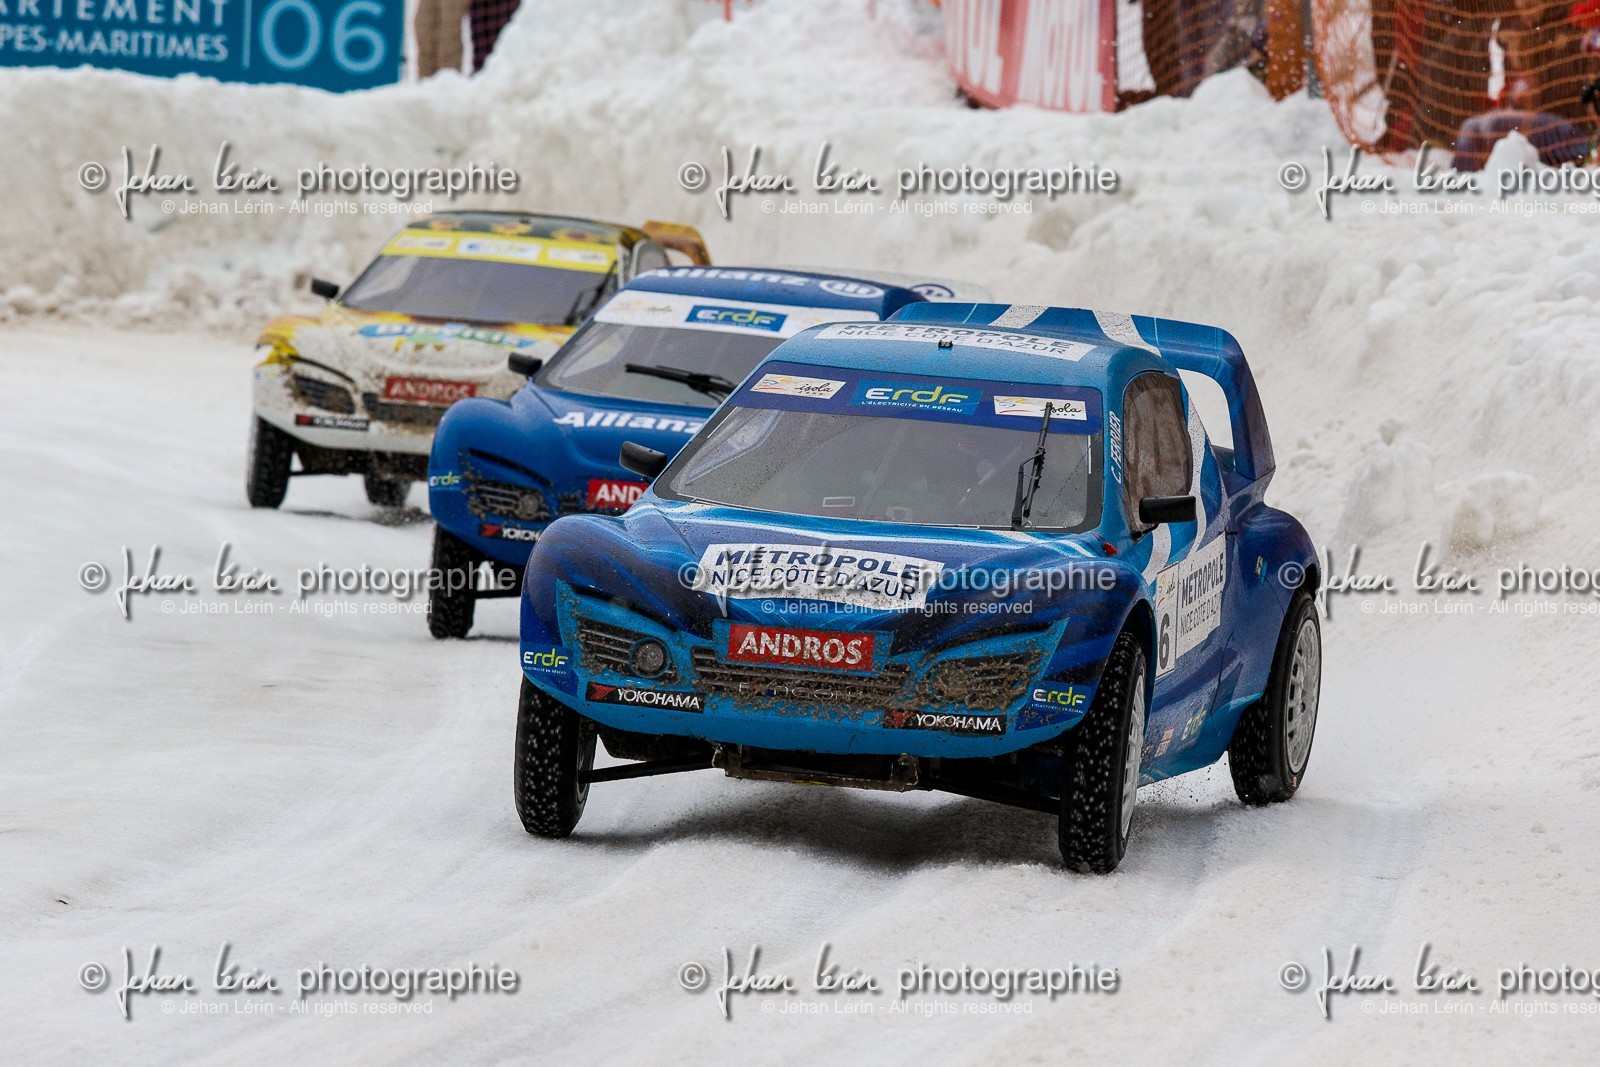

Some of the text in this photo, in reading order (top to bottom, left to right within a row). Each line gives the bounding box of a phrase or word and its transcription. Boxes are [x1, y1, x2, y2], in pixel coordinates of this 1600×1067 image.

[260, 0, 387, 75] 06
[553, 411, 703, 435] Allianz
[1109, 410, 1122, 470] FERRIER
[711, 566, 764, 586] NICE
[737, 631, 863, 665] ANDROS
[1159, 613, 1170, 669] 6
[617, 688, 701, 710] YOKOHAMA
[915, 713, 1002, 732] YOKOHAMA
